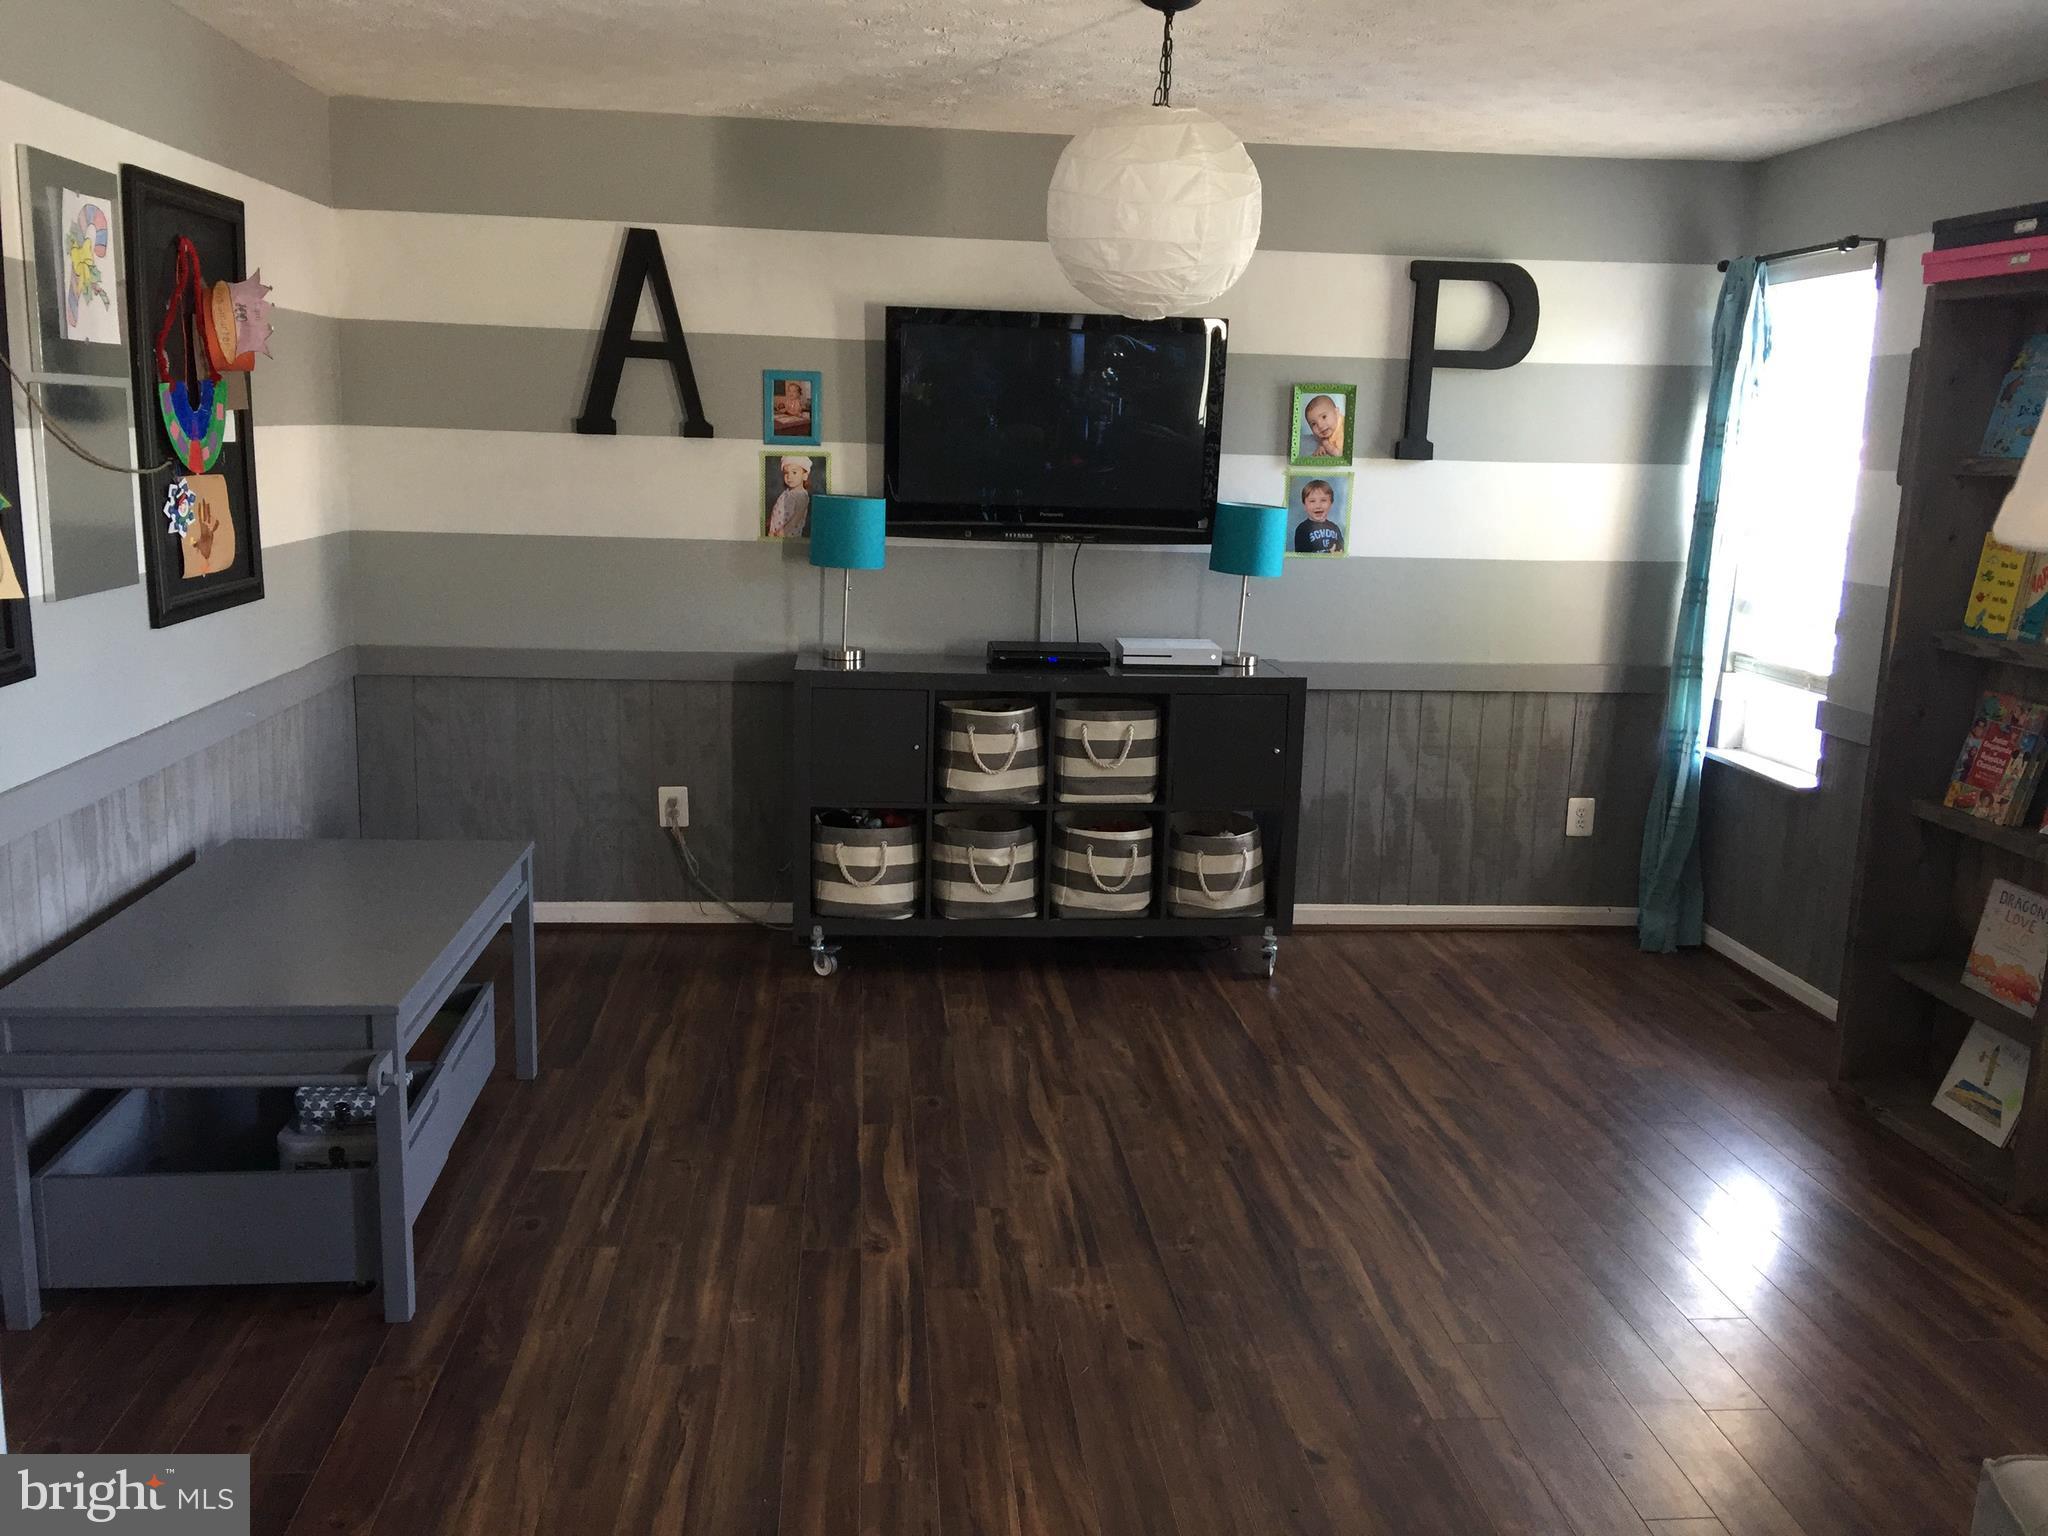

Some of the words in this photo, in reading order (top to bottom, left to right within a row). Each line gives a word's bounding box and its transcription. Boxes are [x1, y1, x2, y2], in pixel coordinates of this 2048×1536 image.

[571, 227, 714, 438] A
[1395, 259, 1540, 460] P
[1309, 529, 1338, 543] SCHOOL
[2006, 909, 2037, 935] LOVE
